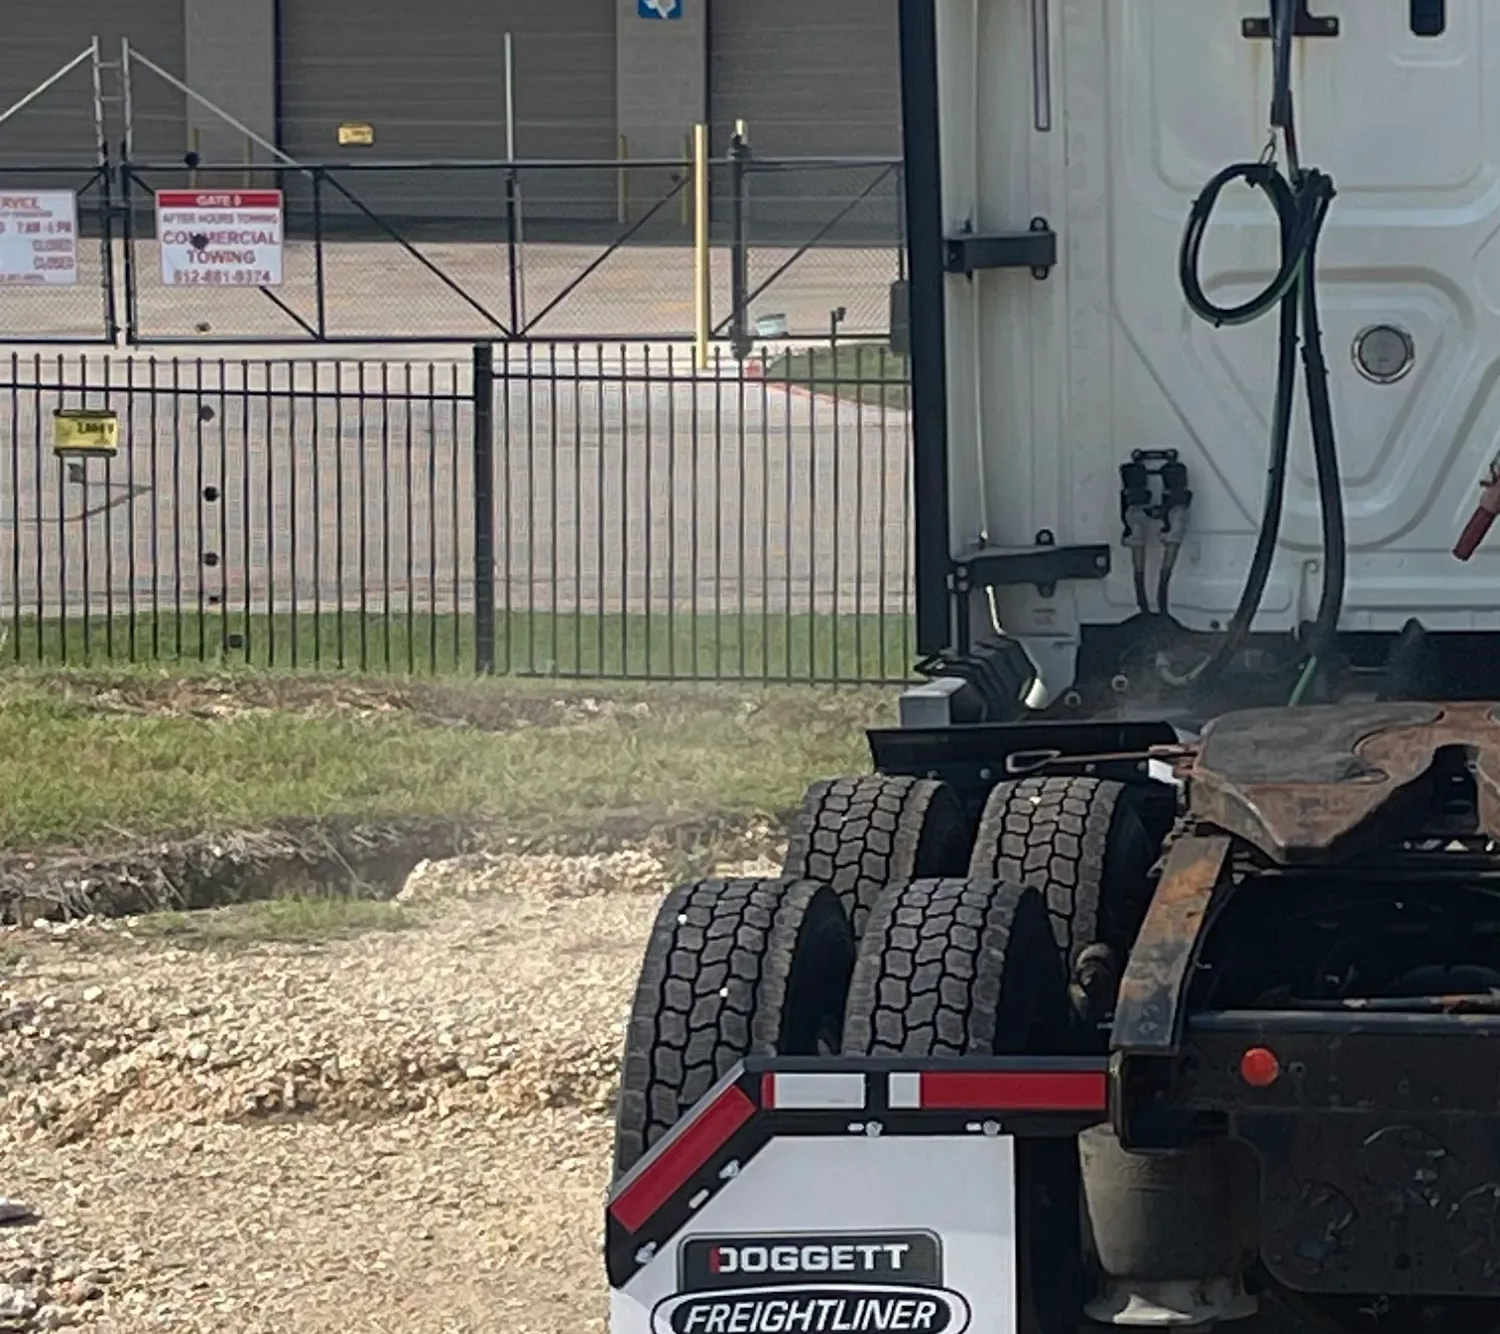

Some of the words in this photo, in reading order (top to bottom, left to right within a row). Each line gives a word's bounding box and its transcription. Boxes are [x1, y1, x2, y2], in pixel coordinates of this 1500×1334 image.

[196, 195, 230, 207] GATE
[186, 250, 256, 264] TOWING
[709, 1244, 909, 1273] DOGGETT
[683, 1299, 937, 1334] FREIGHTLINER
